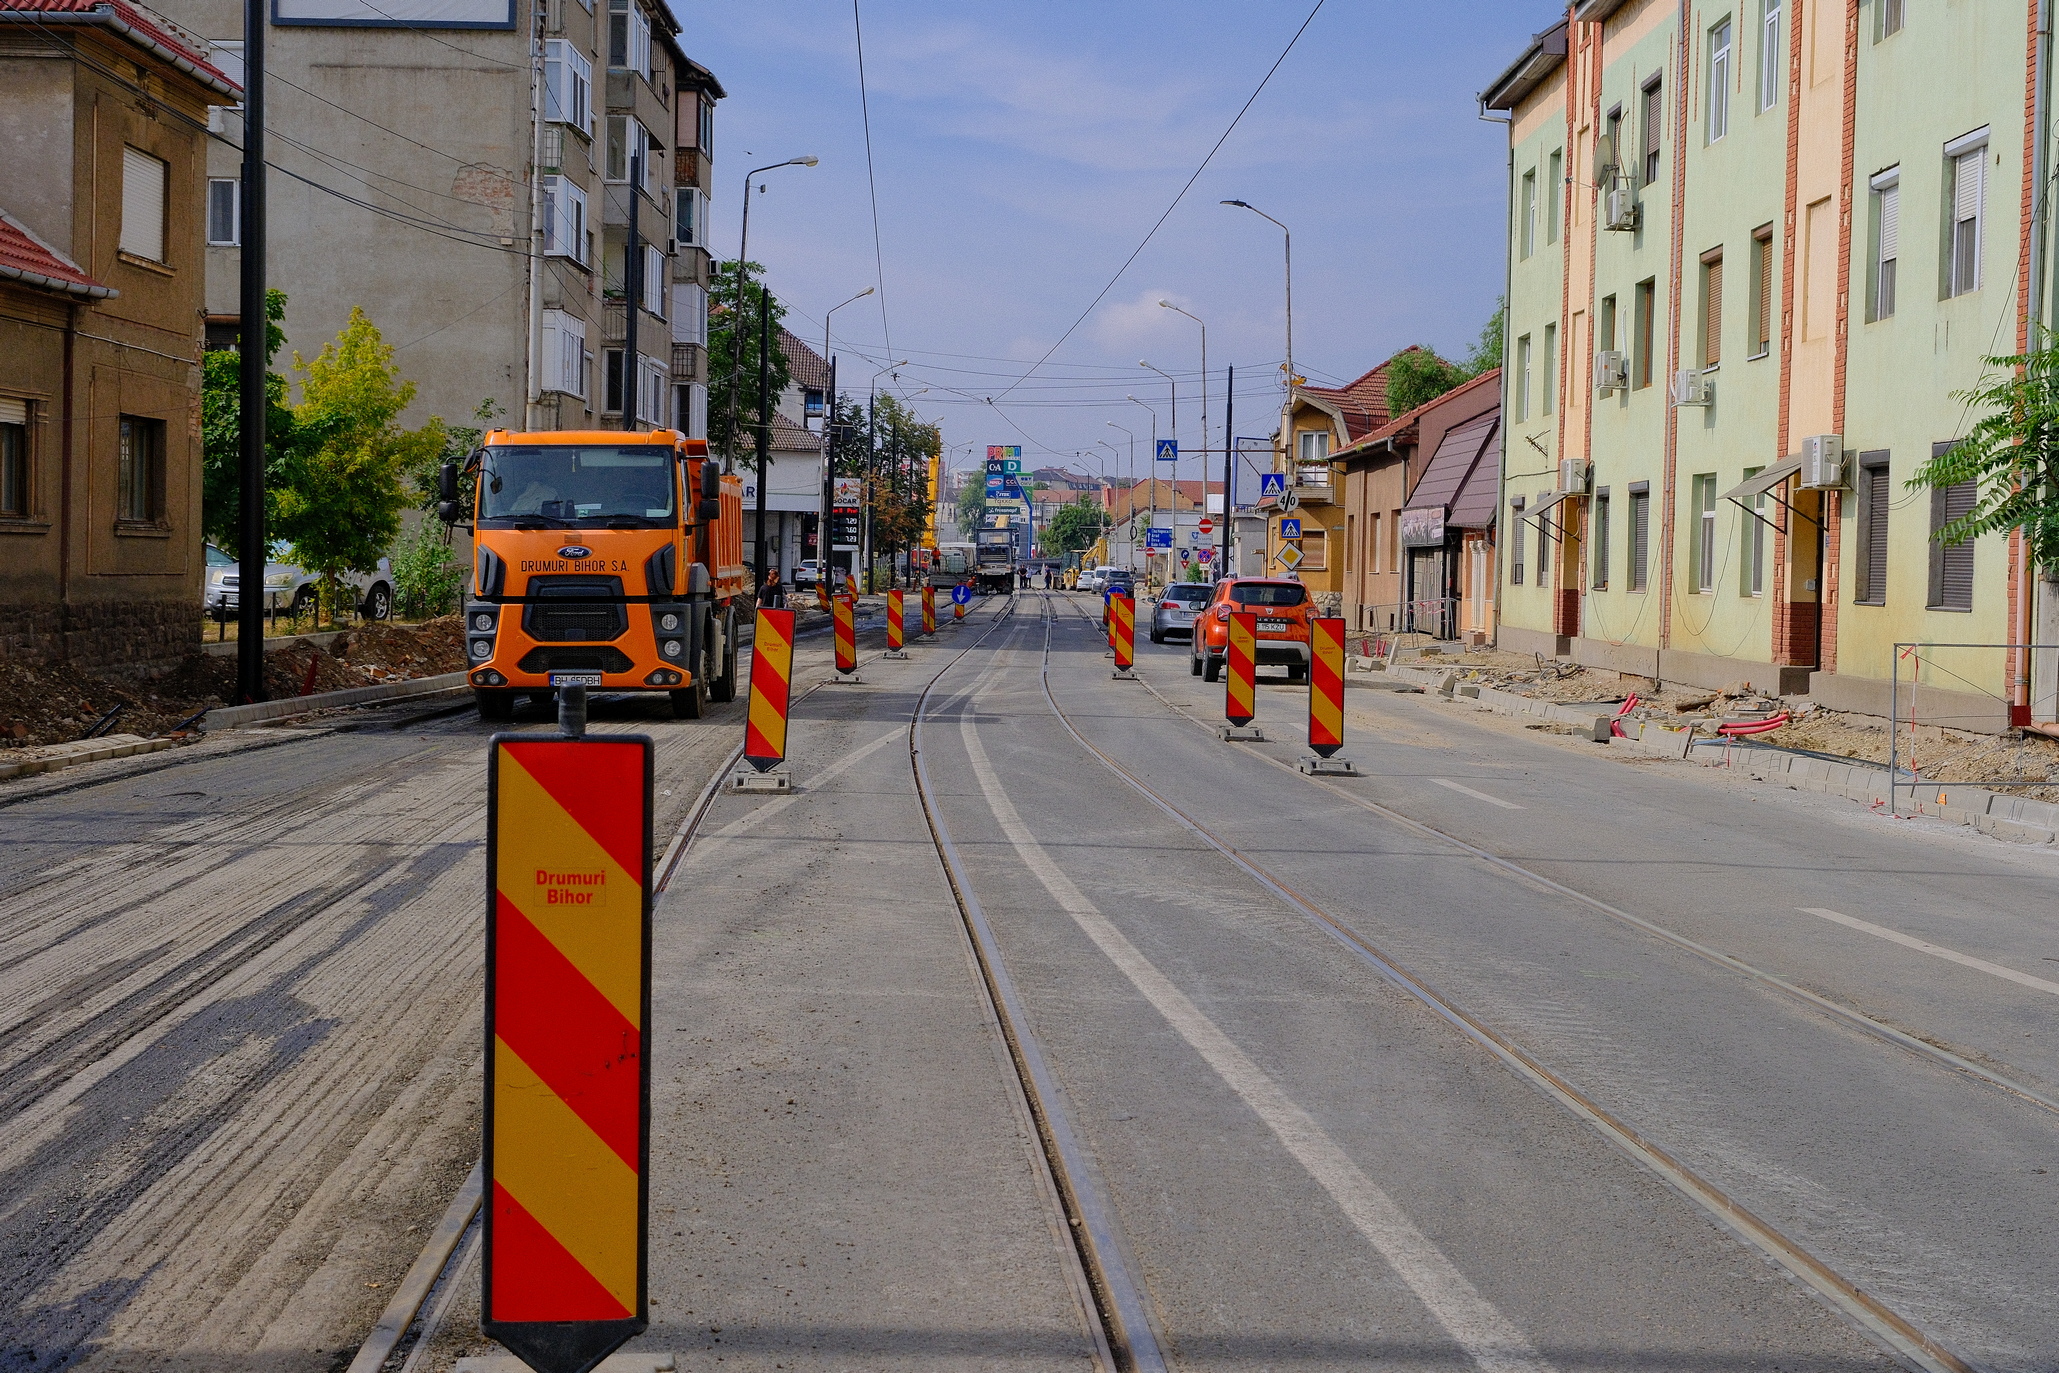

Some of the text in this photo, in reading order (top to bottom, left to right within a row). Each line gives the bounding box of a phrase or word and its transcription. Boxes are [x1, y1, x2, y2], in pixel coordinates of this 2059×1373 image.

[564, 547, 584, 557] Ford
[521, 560, 630, 572] DRUMURI BIHOR S.A.
[536, 869, 606, 885] Drumuri
[547, 888, 594, 904] Bihor
